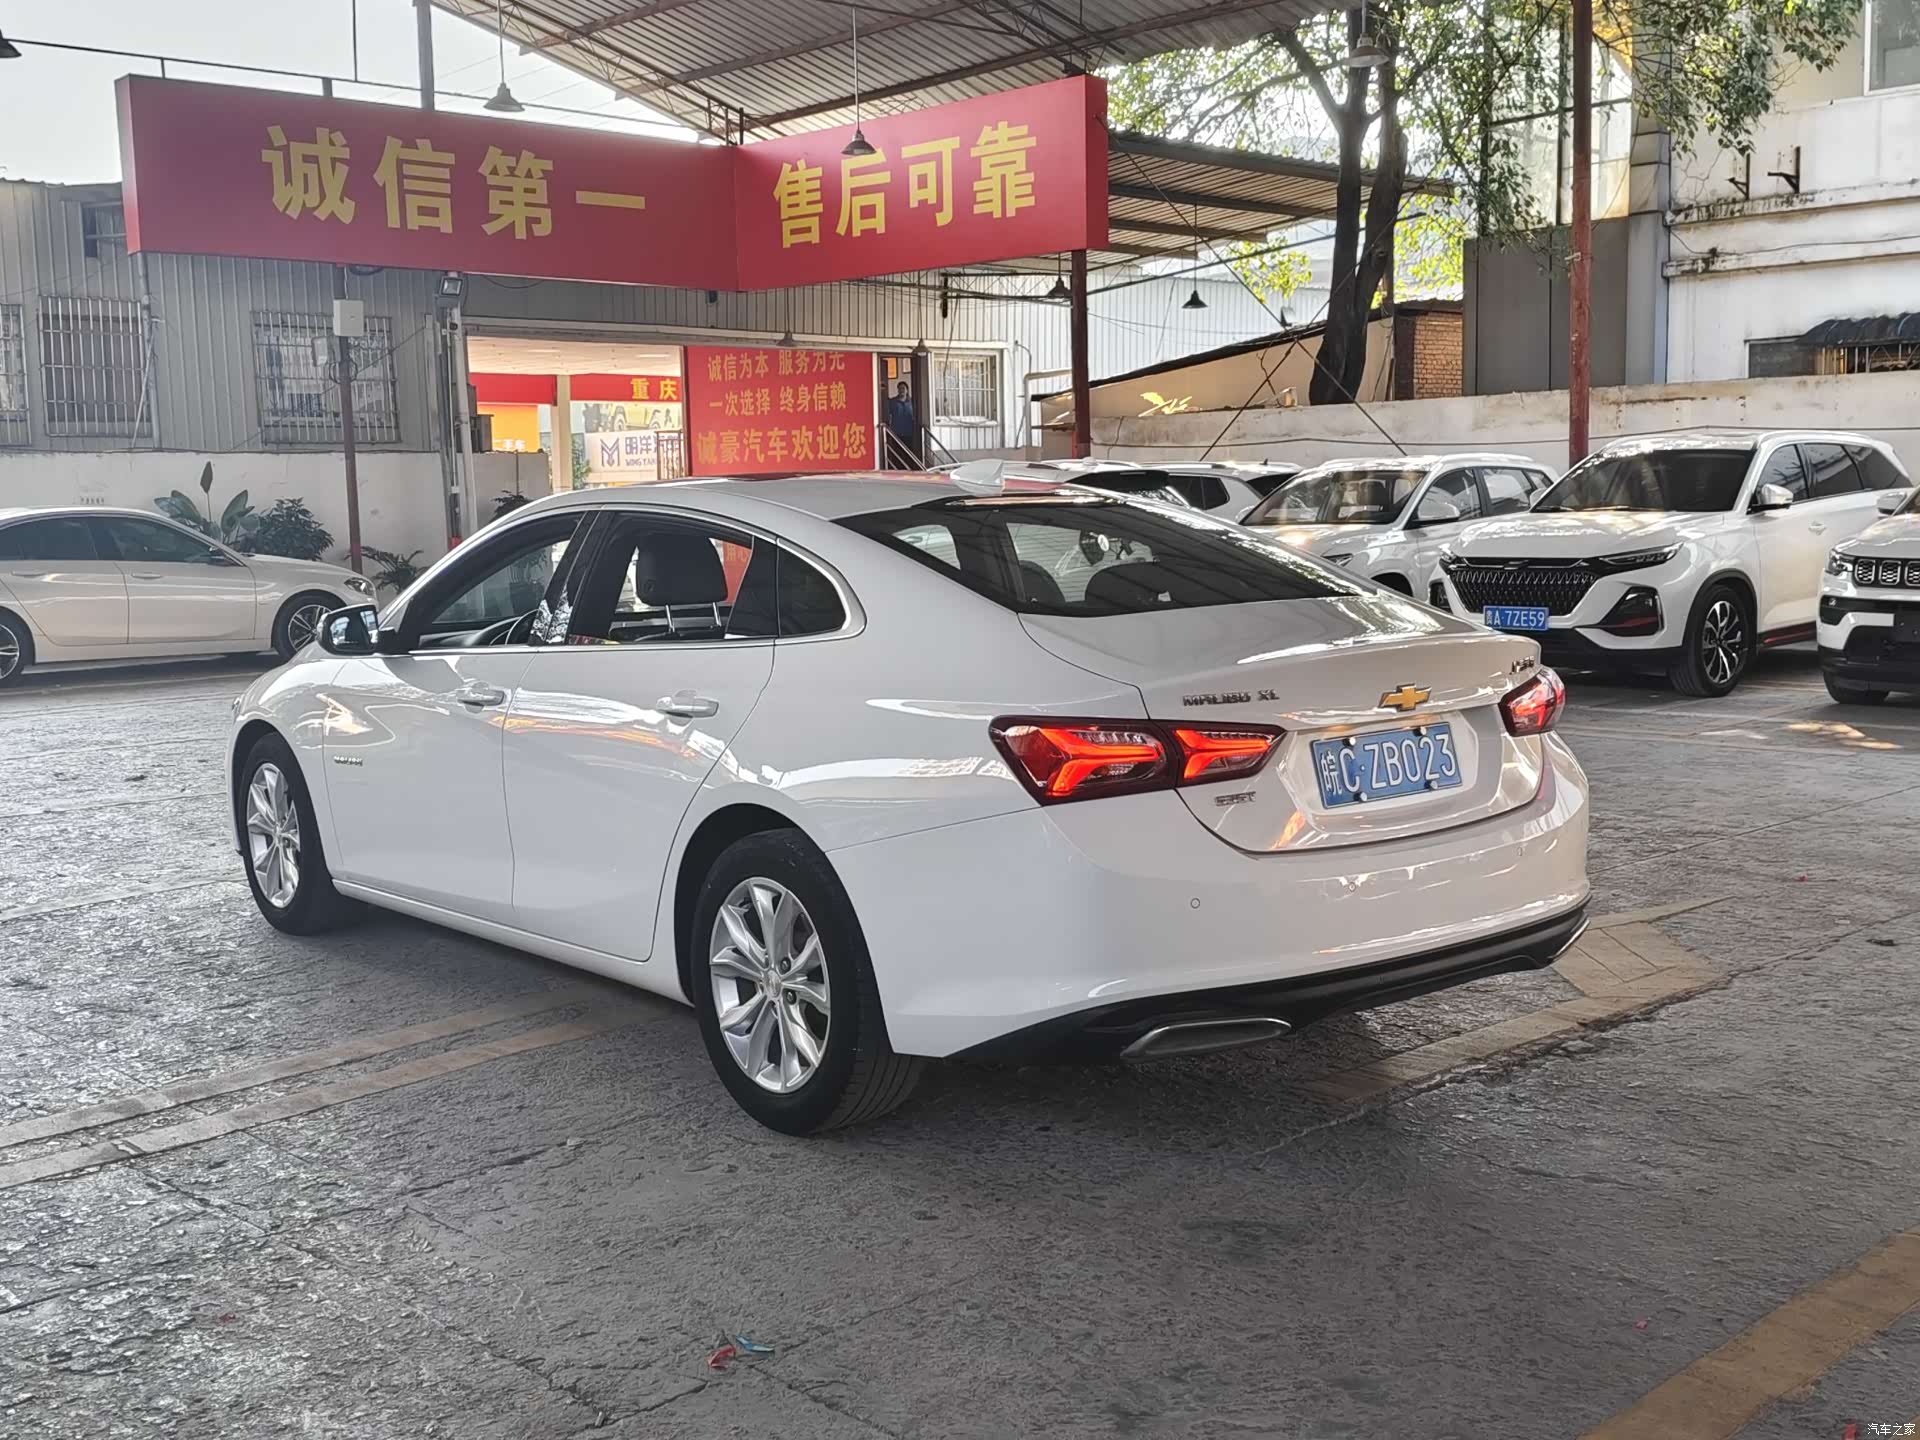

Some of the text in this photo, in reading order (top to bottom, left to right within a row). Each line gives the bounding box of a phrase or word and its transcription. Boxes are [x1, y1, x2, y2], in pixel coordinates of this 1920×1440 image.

[261, 124, 646, 240] 诚信第一
[772, 120, 1037, 249] 售后可靠
[708, 351, 769, 381] 诚信为本
[630, 377, 678, 400] 重庆
[709, 380, 847, 416] 一次选择 终身信赖
[697, 421, 867, 465] 诚豪汽车欢迎您
